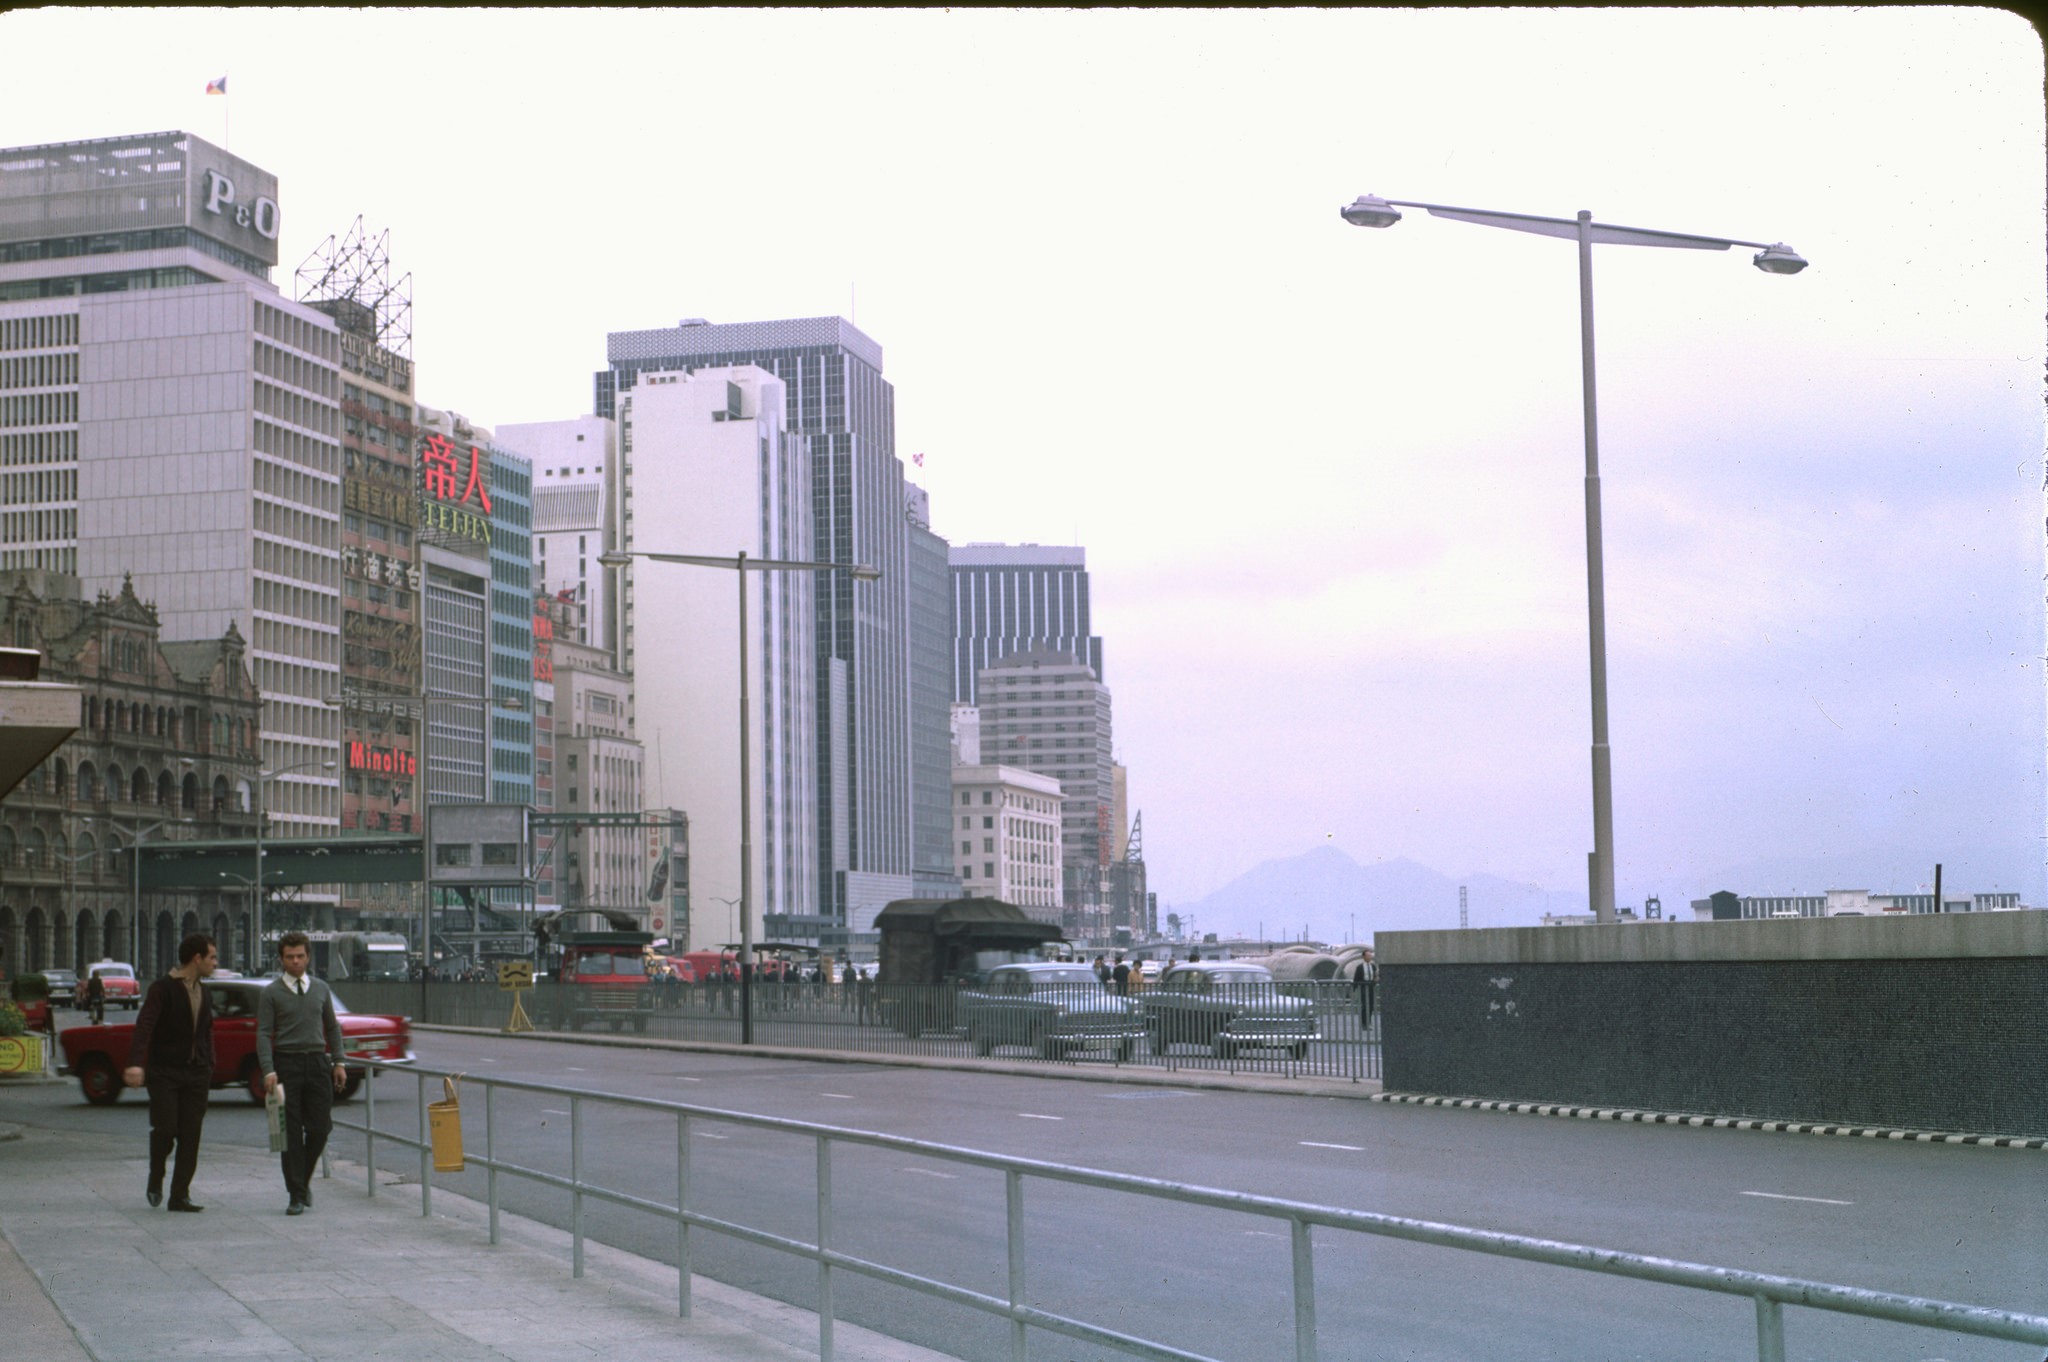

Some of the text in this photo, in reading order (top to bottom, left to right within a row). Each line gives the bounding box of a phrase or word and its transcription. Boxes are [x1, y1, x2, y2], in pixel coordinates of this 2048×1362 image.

[206, 169, 281, 240] P&O
[340, 331, 411, 377] CATHOLIC CENTRE
[423, 434, 492, 516] 帝人
[423, 501, 491, 544] TEIJIN
[350, 739, 417, 776] Minolta
